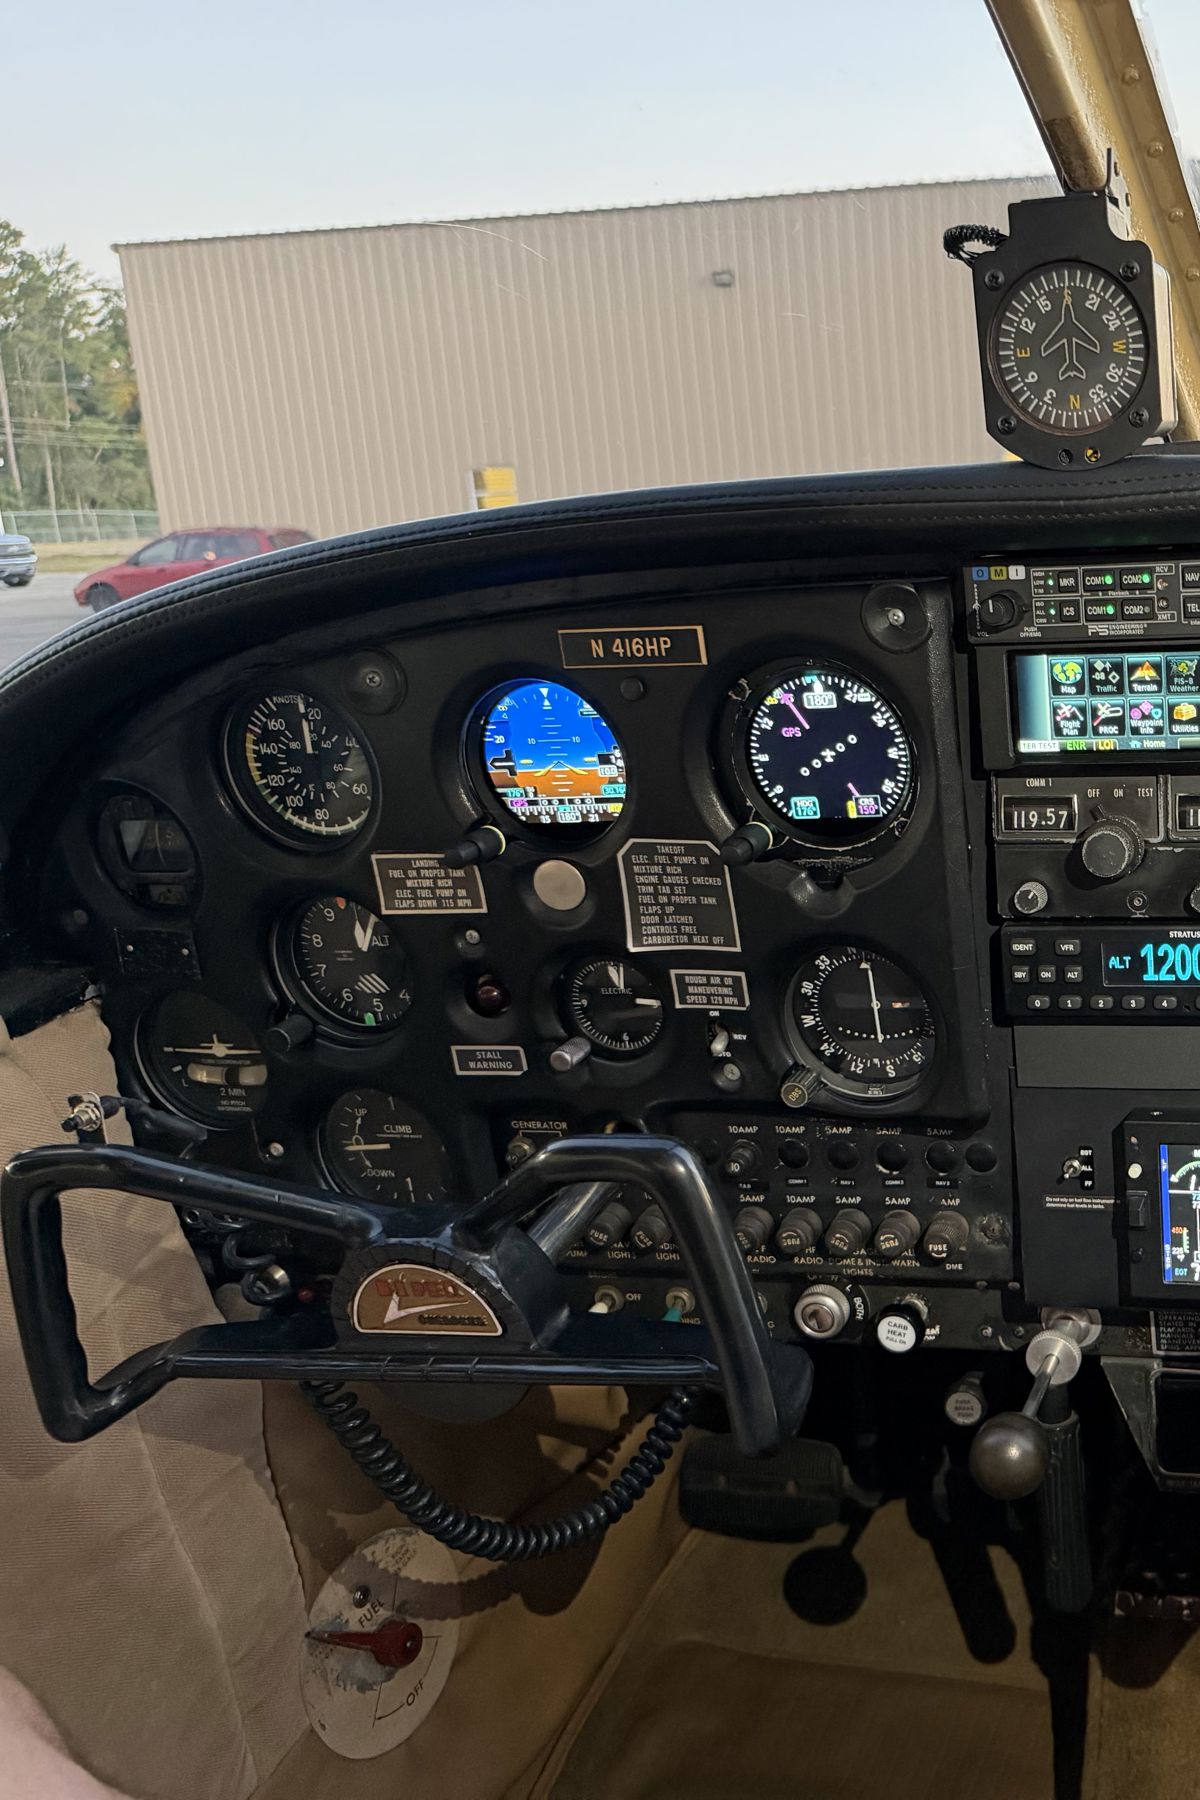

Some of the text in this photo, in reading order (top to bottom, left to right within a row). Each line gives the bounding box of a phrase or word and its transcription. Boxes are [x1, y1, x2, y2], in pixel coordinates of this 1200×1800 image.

[1020, 317, 1036, 334] 12
[1102, 311, 1121, 331] 24
[1113, 339, 1126, 354] W
[1017, 347, 1030, 357] E
[1070, 395, 1080, 409] N
[1085, 577, 1104, 585] COM1
[1123, 576, 1142, 584] COM2
[1088, 606, 1107, 614] COM1
[1124, 606, 1144, 614] COM2
[1187, 603, 1200, 612] TEL
[591, 637, 671, 657] N 416HP
[1132, 684, 1157, 692] Terrain
[308, 708, 321, 719] 20
[268, 719, 285, 730] 160
[1130, 720, 1163, 728] Waypoint
[782, 727, 801, 737] GPS
[1067, 742, 1086, 750] ENR
[1143, 740, 1166, 748] Home
[260, 743, 278, 755] 140
[267, 775, 284, 786] 120
[1026, 778, 1046, 787] COMM
[353, 784, 367, 794] 60
[1088, 789, 1100, 798] OFF
[1113, 788, 1123, 798] ON
[1138, 787, 1153, 798] TEST
[286, 796, 303, 807] 100
[315, 809, 329, 820] 80
[1013, 808, 1068, 828] 119.57
[657, 845, 685, 854] TAKEOFF
[655, 856, 671, 864] FUEL
[674, 856, 696, 864] PUMPS
[700, 856, 709, 864] ON
[633, 866, 682, 874] MIXTURE RICH
[663, 876, 689, 884] GAUGES
[693, 877, 721, 885] CHECKED
[638, 886, 687, 894] TRIM TAB SET
[671, 896, 697, 904] PROPER
[700, 897, 717, 905] TANK
[640, 906, 674, 914] FLAPS UP
[641, 916, 693, 924] DOOR LATCHED
[642, 926, 697, 934] CONTROLS FREE
[371, 936, 389, 946] ALT
[643, 935, 688, 944] CARBURETOR
[713, 936, 724, 944] OFF
[1060, 944, 1074, 952] VFR
[1109, 956, 1131, 969] ALT
[688, 986, 733, 995] MANEUVERING
[789, 1088, 802, 1101] OBS
[384, 1124, 412, 1133] CLIMB
[512, 1121, 567, 1130] GENERATOR
[728, 1126, 758, 1134] 10AMP
[775, 1126, 806, 1134] 10AMP
[825, 1126, 852, 1134] 5AMP
[367, 1168, 395, 1177] DOWN
[740, 1194, 765, 1202] 5AMP
[786, 1195, 816, 1203] 10AMP
[836, 1196, 862, 1204] 5AMP
[885, 1196, 911, 1205] 5AMP
[929, 1244, 948, 1252] FUSE
[747, 1255, 776, 1264] RADIO
[794, 1256, 824, 1265] RADIO
[854, 1297, 864, 1320] BOTH
[888, 1321, 908, 1331] CARB
[888, 1329, 906, 1338] HEAT
[357, 1599, 385, 1629] FUEL
[406, 1679, 425, 1707] OFF
